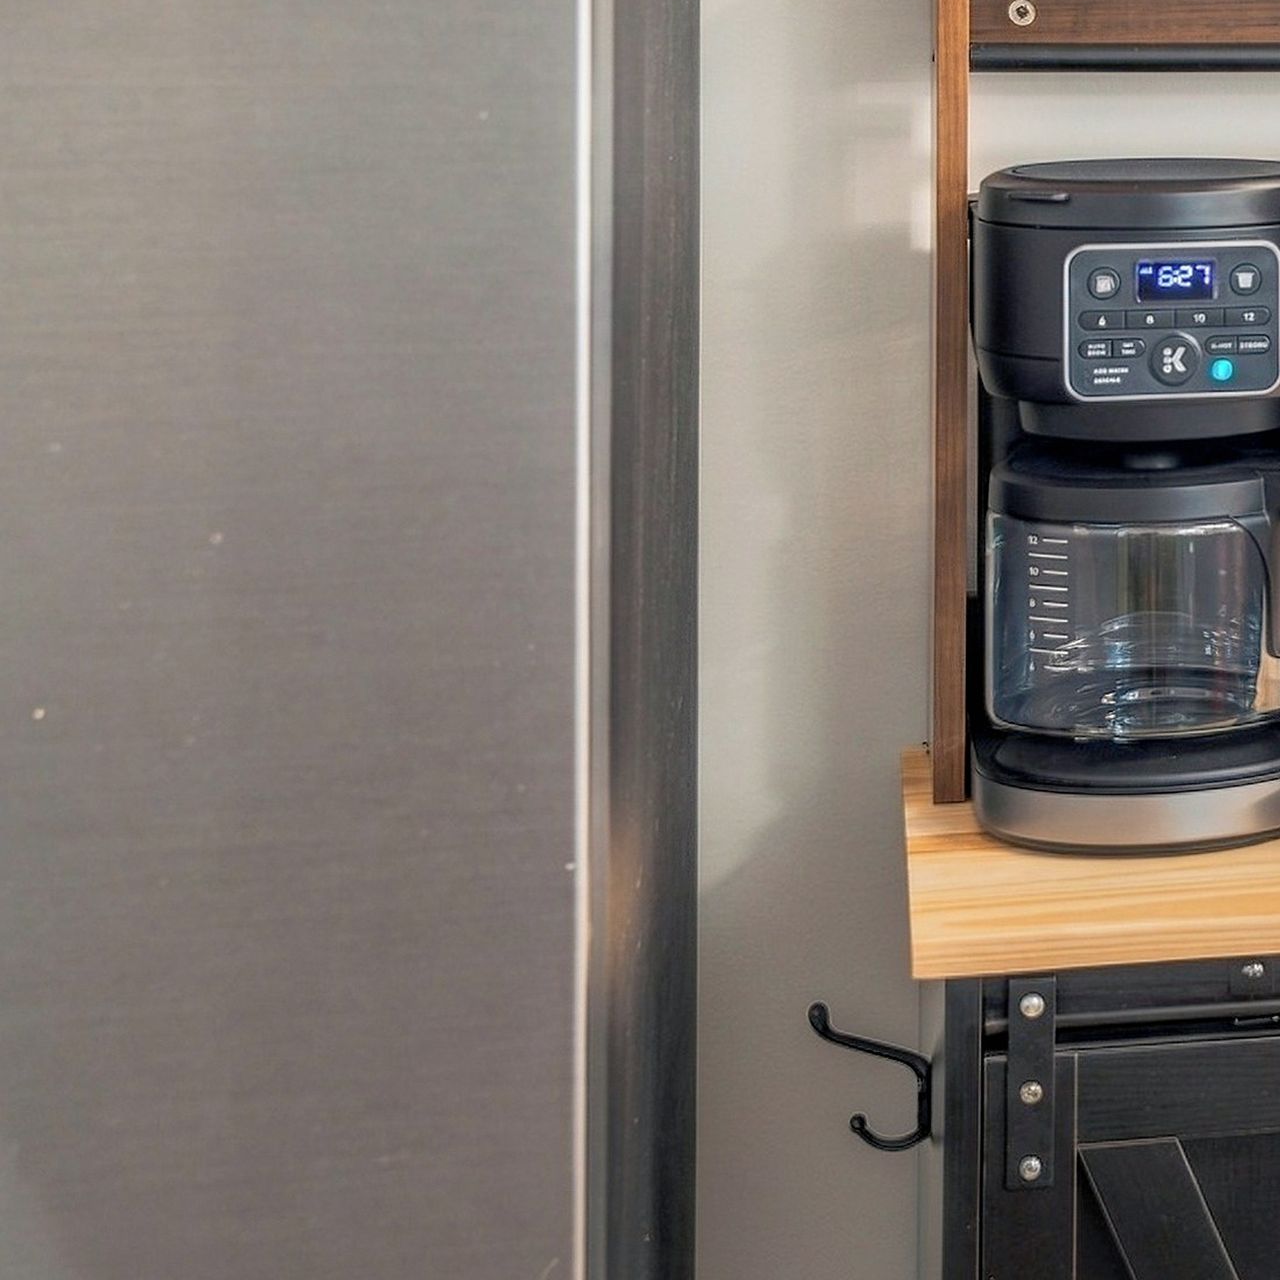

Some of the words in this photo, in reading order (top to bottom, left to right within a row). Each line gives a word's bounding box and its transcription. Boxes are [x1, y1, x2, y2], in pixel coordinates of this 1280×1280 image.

[1158, 265, 1211, 288] 6:27
[1098, 316, 1107, 327] 6
[1146, 315, 1155, 325] 8
[1193, 313, 1206, 324] 10
[1243, 311, 1256, 322] 12
[1027, 535, 1038, 545] 12
[1029, 566, 1039, 576] 10
[1029, 598, 1036, 608] 8
